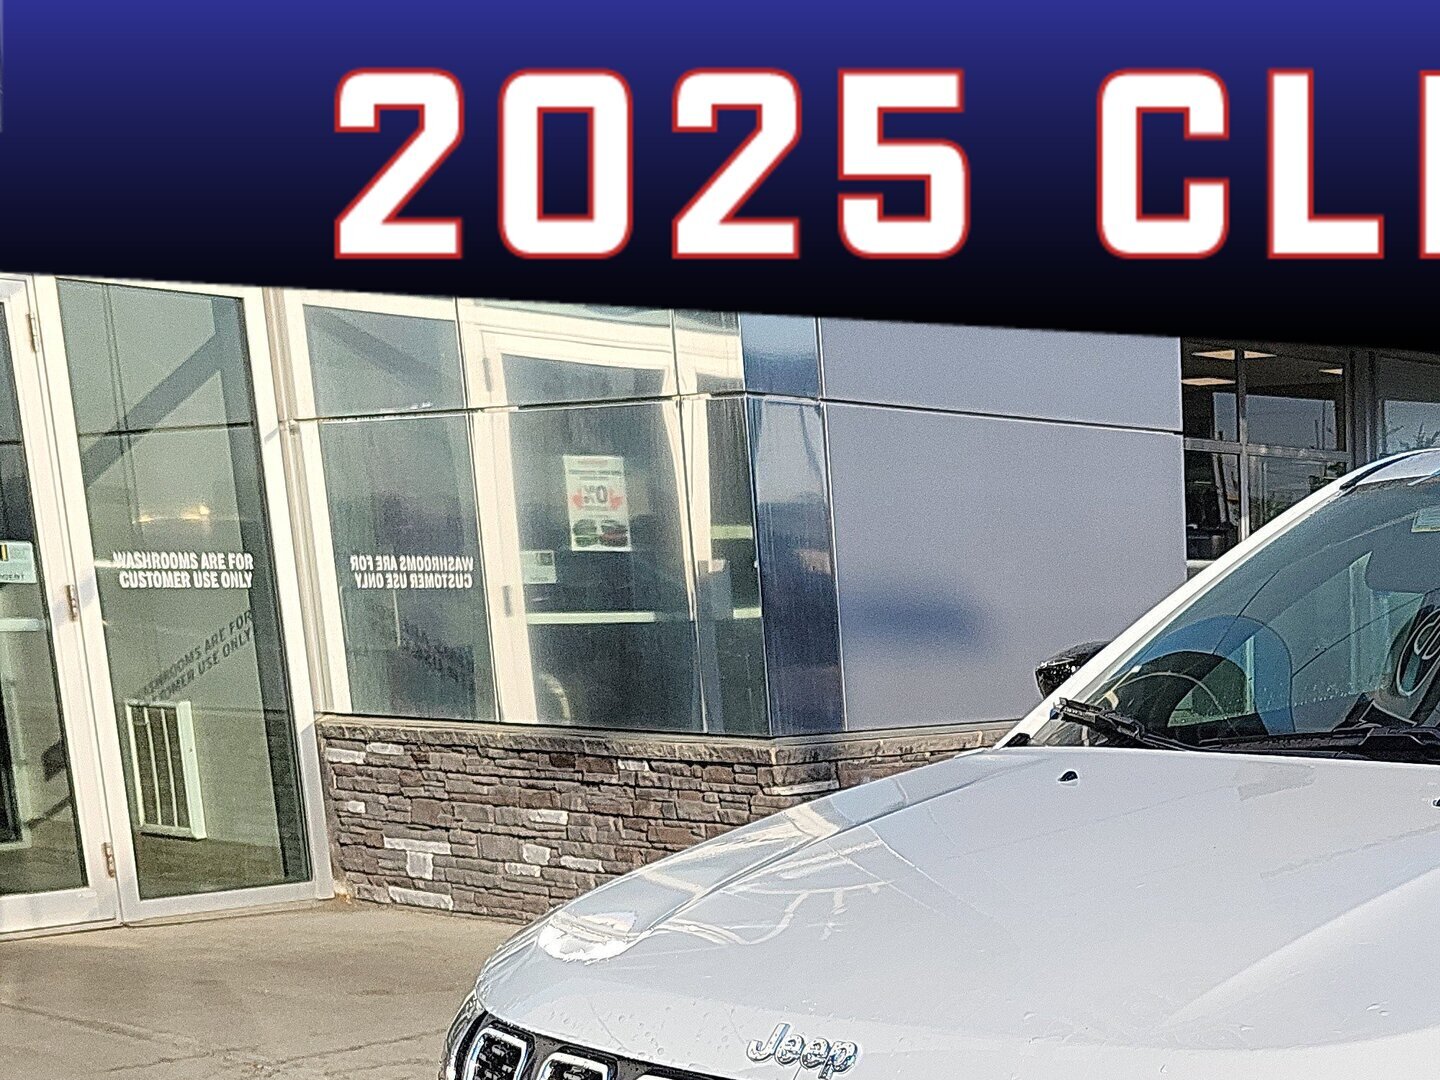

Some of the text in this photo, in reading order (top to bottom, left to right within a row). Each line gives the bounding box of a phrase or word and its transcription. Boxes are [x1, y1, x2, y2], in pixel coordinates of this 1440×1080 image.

[113, 552, 254, 570] WASHROOMS ARE FOR
[119, 571, 252, 588] CUSTOMER USE ONLY
[229, 610, 253, 635] FOR
[222, 627, 251, 657] ONLY
[746, 1023, 858, 1080] Jeep
